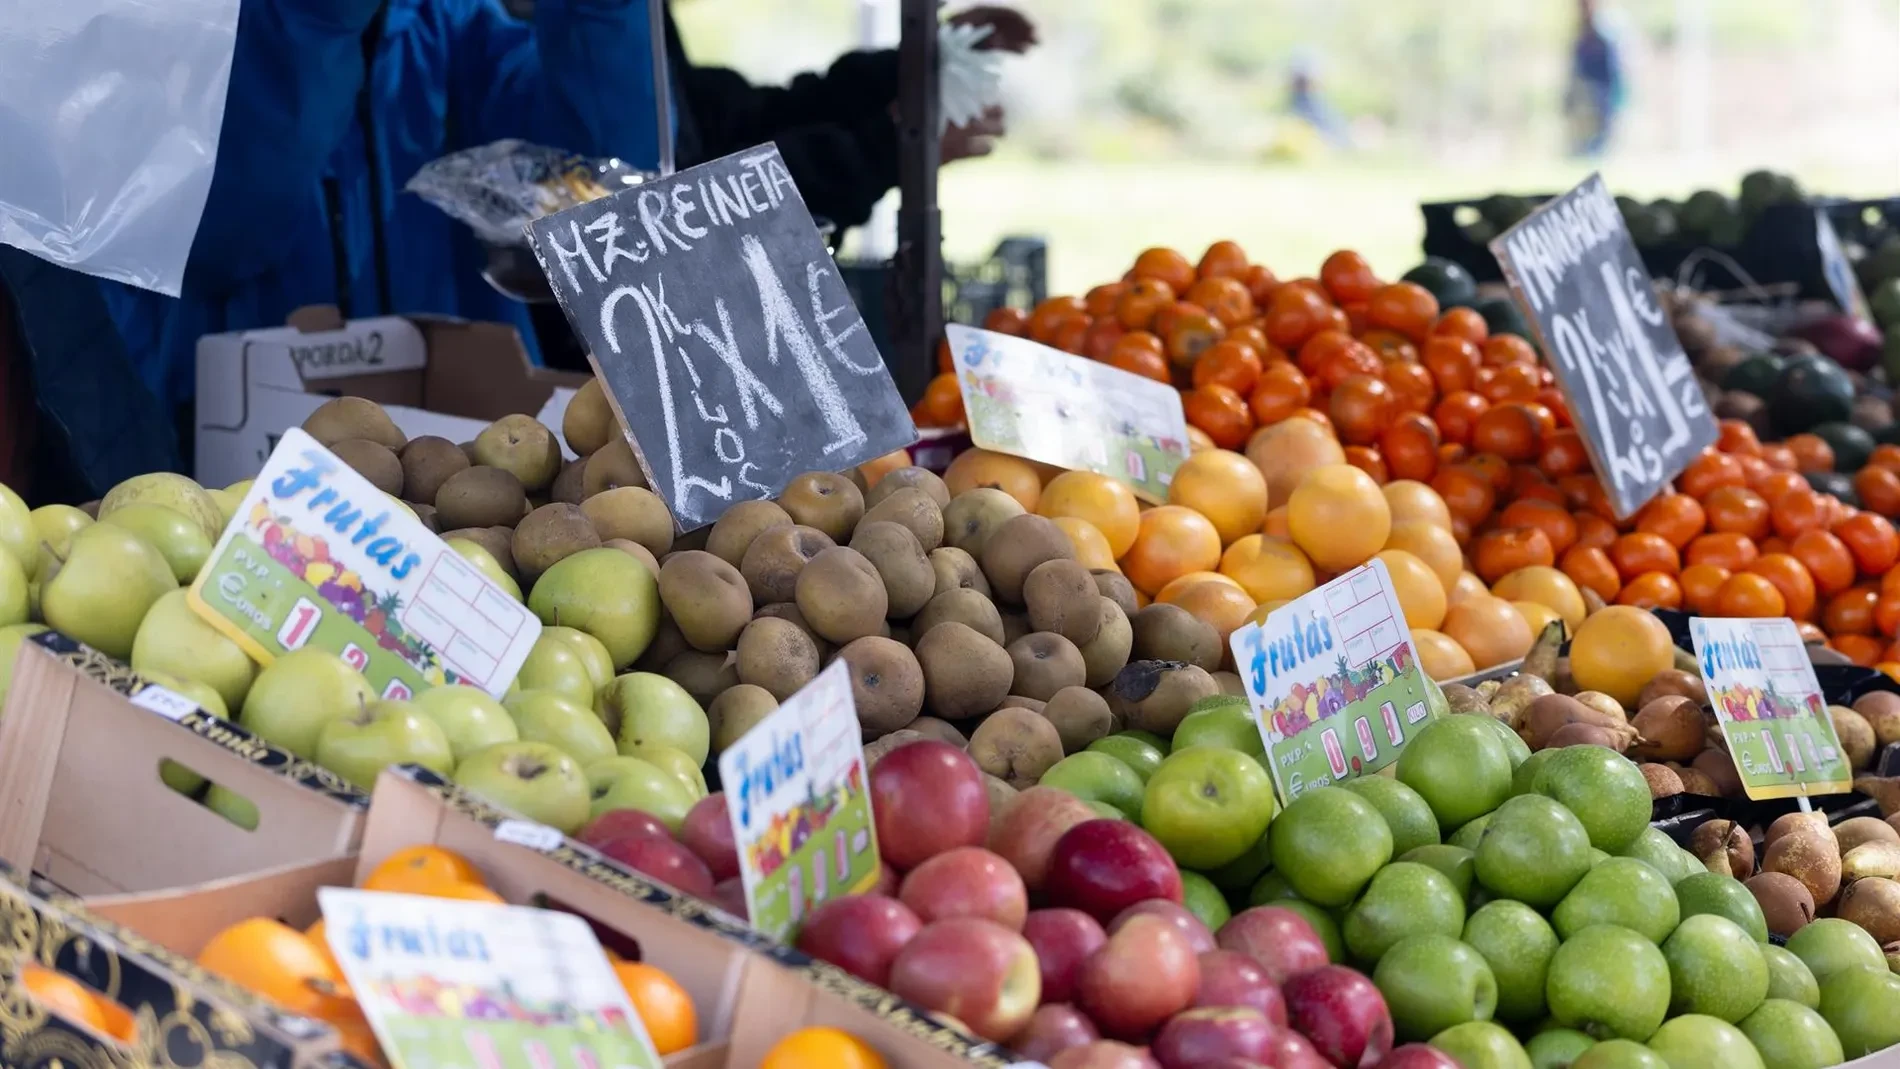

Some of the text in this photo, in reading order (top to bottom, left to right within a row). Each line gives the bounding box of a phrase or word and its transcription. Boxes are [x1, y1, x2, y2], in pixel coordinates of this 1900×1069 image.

[600, 284, 732, 524] 2
[1552, 312, 1647, 492] 2
[271, 449, 421, 580] Frutas
[1245, 613, 1333, 697] Frutas
[1697, 622, 1762, 680] Frutas
[734, 731, 804, 828] Frutas
[346, 905, 491, 961] Frutas
